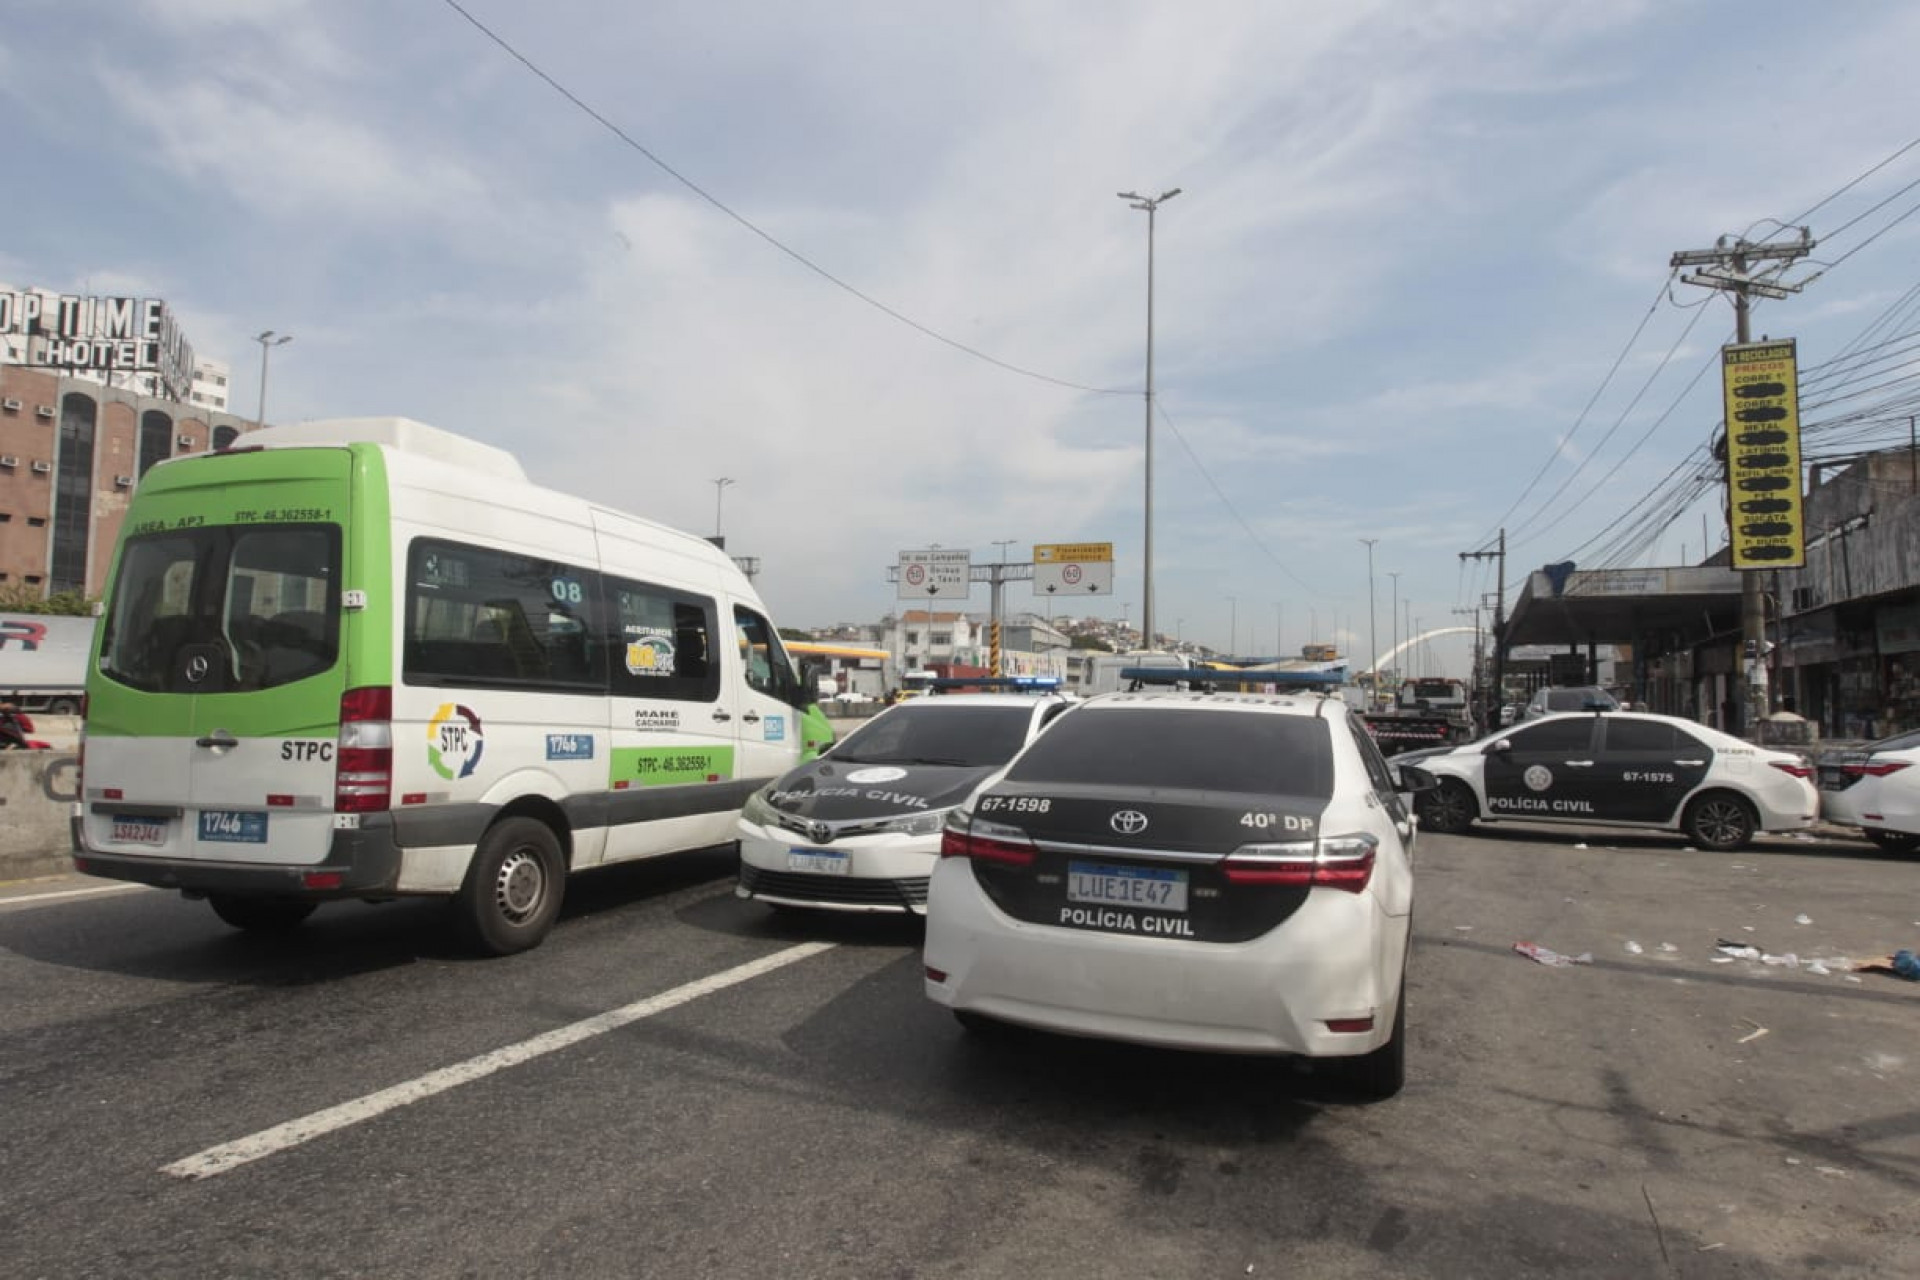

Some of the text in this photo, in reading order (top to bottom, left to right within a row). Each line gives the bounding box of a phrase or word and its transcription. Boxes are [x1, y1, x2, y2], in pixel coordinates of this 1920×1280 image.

[60, 295, 162, 340] TIME
[47, 340, 158, 368] HOTEL
[1735, 373, 1771, 383] COBRE
[1744, 423, 1779, 431] METAL
[1739, 446, 1787, 454] LATINHA
[1743, 514, 1788, 522] SUCATA
[552, 580, 583, 603] 08
[441, 726, 468, 752] STPC
[549, 735, 577, 753] 1746
[281, 740, 333, 762] STPC
[1622, 771, 1675, 783] 67-1575
[865, 790, 930, 810] CIVIL
[981, 797, 1051, 813] 67-1598
[1488, 796, 1595, 813] POLÍCIA CIVIL
[203, 811, 241, 834] 1746
[1284, 815, 1314, 831] DP
[1078, 876, 1172, 904] LUE1E47
[1060, 907, 1195, 936] POLÍCIA CIVIL
